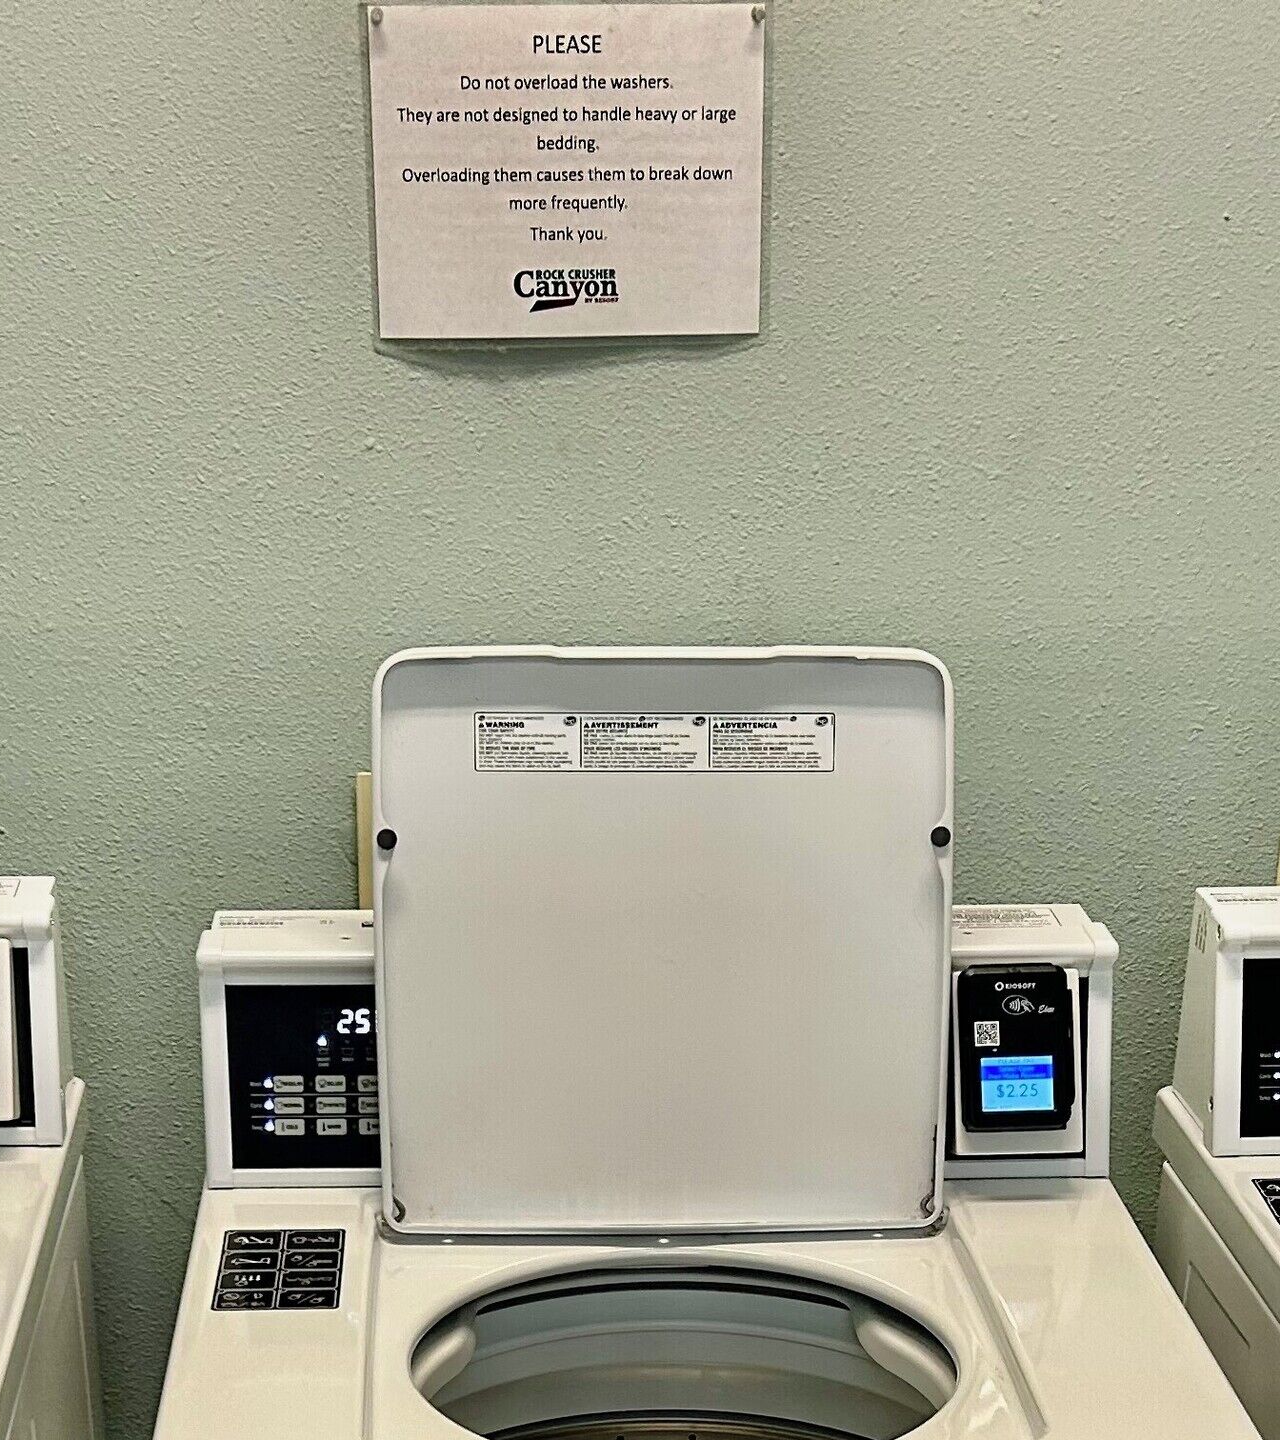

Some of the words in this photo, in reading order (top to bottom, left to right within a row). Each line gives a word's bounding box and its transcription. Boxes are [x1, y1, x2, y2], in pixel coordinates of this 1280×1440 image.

[532, 34, 602, 54] PLEASE
[460, 75, 481, 90] Do
[485, 76, 510, 90] not
[514, 74, 578, 90] overload
[582, 74, 607, 89] the
[610, 74, 673, 89] washers.
[396, 107, 432, 125] They
[436, 110, 460, 122] are
[464, 108, 489, 122] not
[493, 107, 558, 125] designed
[562, 108, 578, 121] to
[582, 106, 631, 121] handle
[635, 106, 677, 124] heavy
[681, 109, 697, 121] or
[701, 106, 736, 123] large
[536, 135, 600, 153] bedding.
[402, 167, 490, 185] Overloading
[494, 167, 532, 182] them
[536, 169, 584, 182] causes
[588, 167, 626, 181] them
[630, 168, 645, 181] to
[649, 166, 689, 181] break
[693, 166, 733, 180] down
[509, 199, 547, 210] more
[551, 194, 628, 213] frequently.
[530, 226, 574, 241] Thank
[577, 229, 607, 243] you.
[535, 269, 565, 280] ROCK
[568, 268, 616, 280] CRUSHER
[513, 270, 619, 305] Canyon
[485, 721, 525, 729] WARNING
[336, 1008, 378, 1034] 25
[996, 1083, 1039, 1098] $2.25
